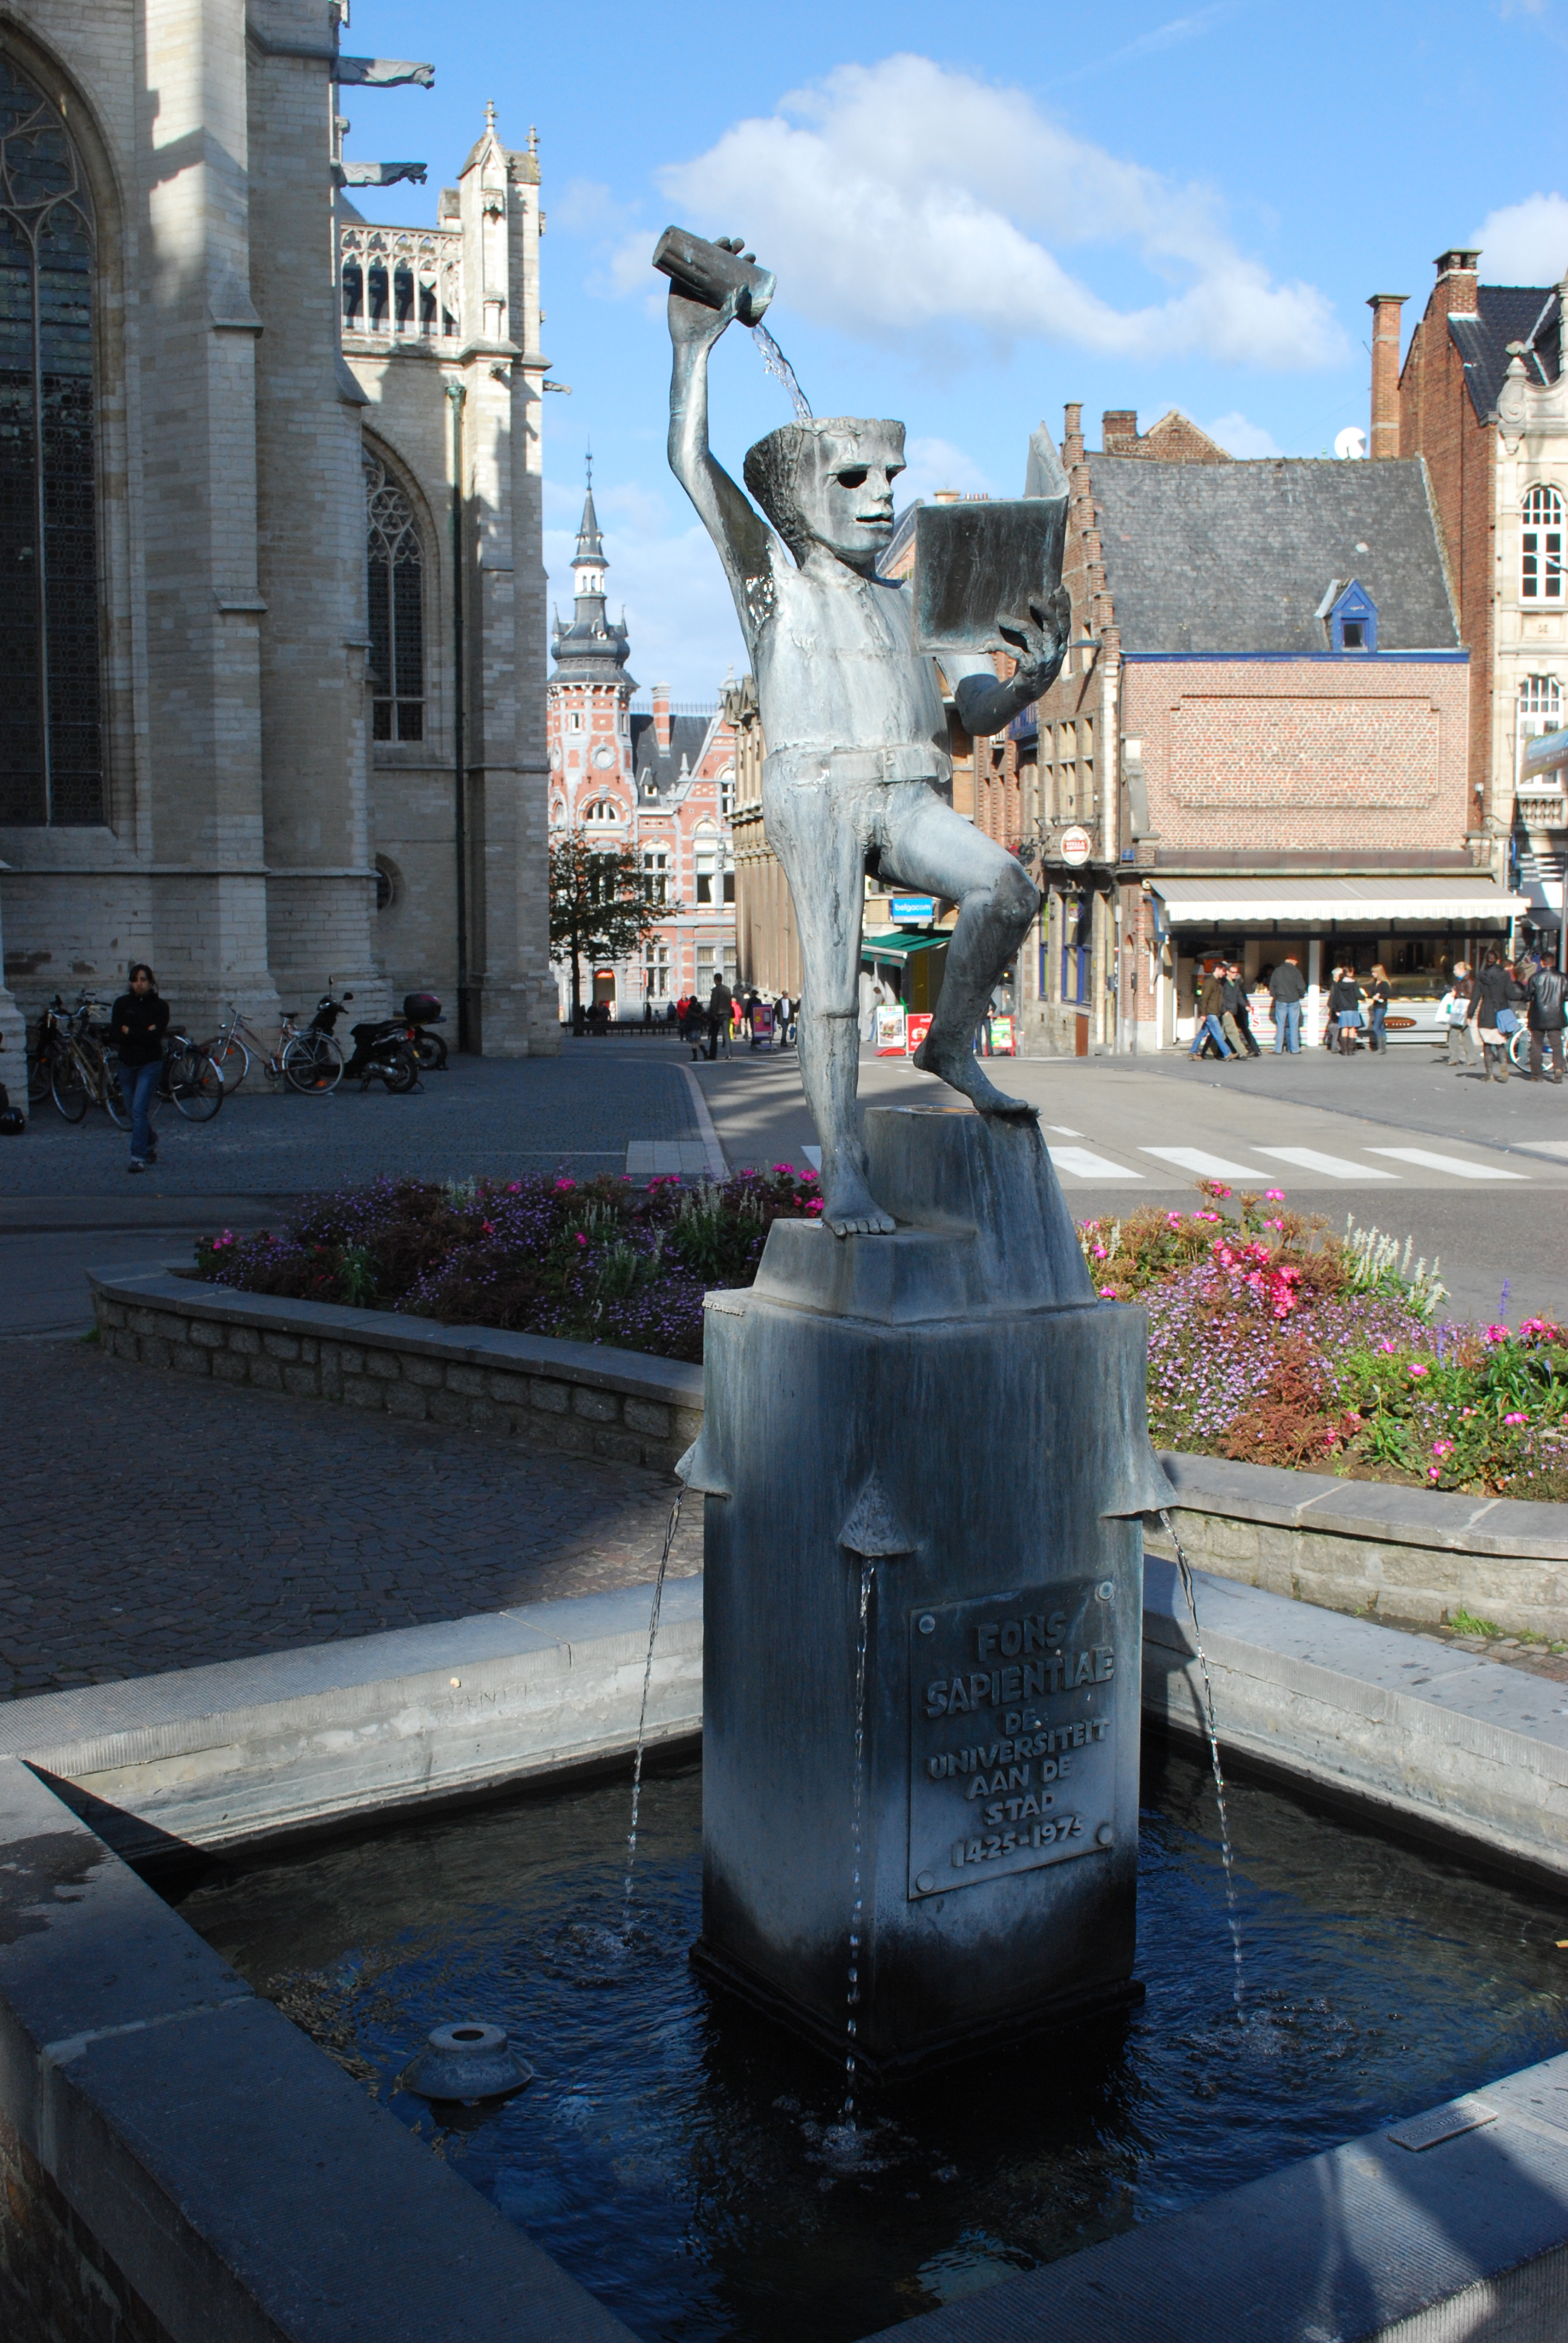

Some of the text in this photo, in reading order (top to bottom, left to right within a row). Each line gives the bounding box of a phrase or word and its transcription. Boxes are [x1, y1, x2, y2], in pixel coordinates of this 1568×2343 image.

[895, 903, 931, 912] belgacom
[976, 1612, 1067, 1662] FONS
[925, 1643, 1115, 1718] SAPIENTIAE
[1003, 1709, 1036, 1735] DE
[927, 1719, 1110, 1778] UNIVERSITEIT
[966, 1757, 1071, 1800] AAN DE
[984, 1792, 1056, 1826] STAD
[951, 1815, 1085, 1868] 1425-1975
